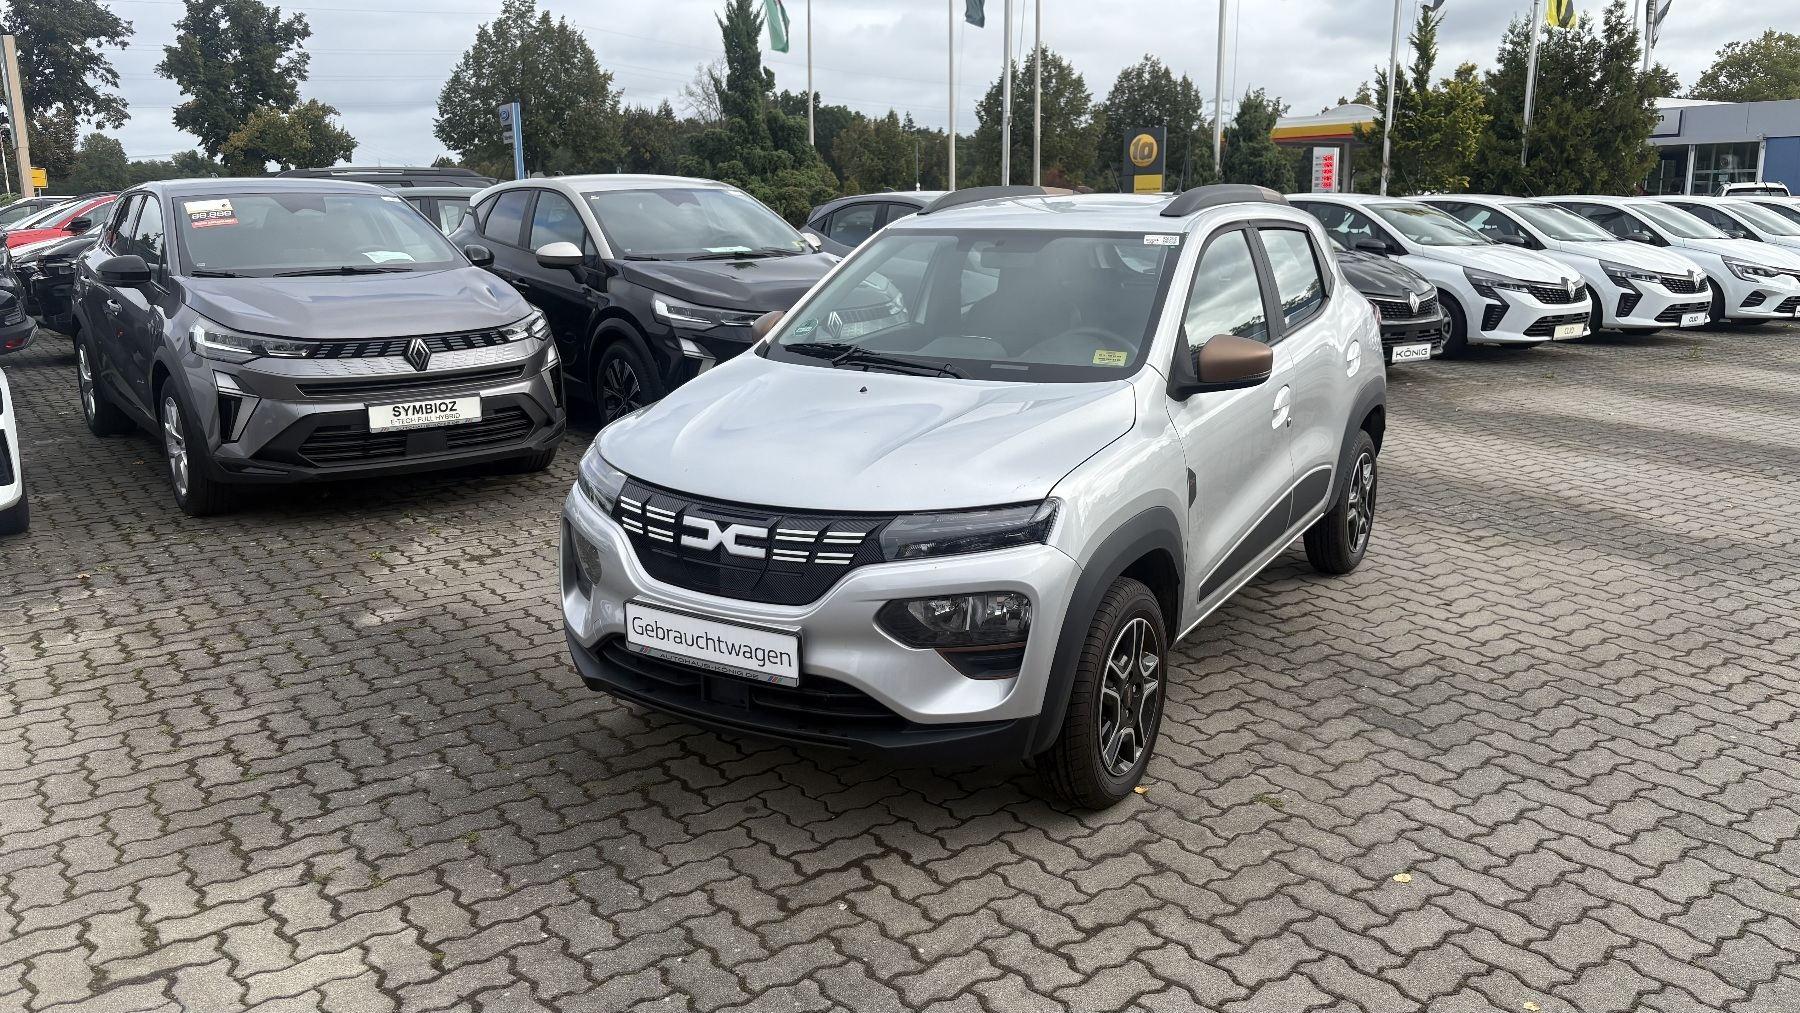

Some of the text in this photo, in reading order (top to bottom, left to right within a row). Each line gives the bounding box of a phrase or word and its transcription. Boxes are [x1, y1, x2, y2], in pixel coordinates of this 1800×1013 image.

[1395, 347, 1428, 358] KÖNIG
[392, 401, 458, 417] SYMBIOZ
[632, 616, 792, 667] Gebrauchtwagen
